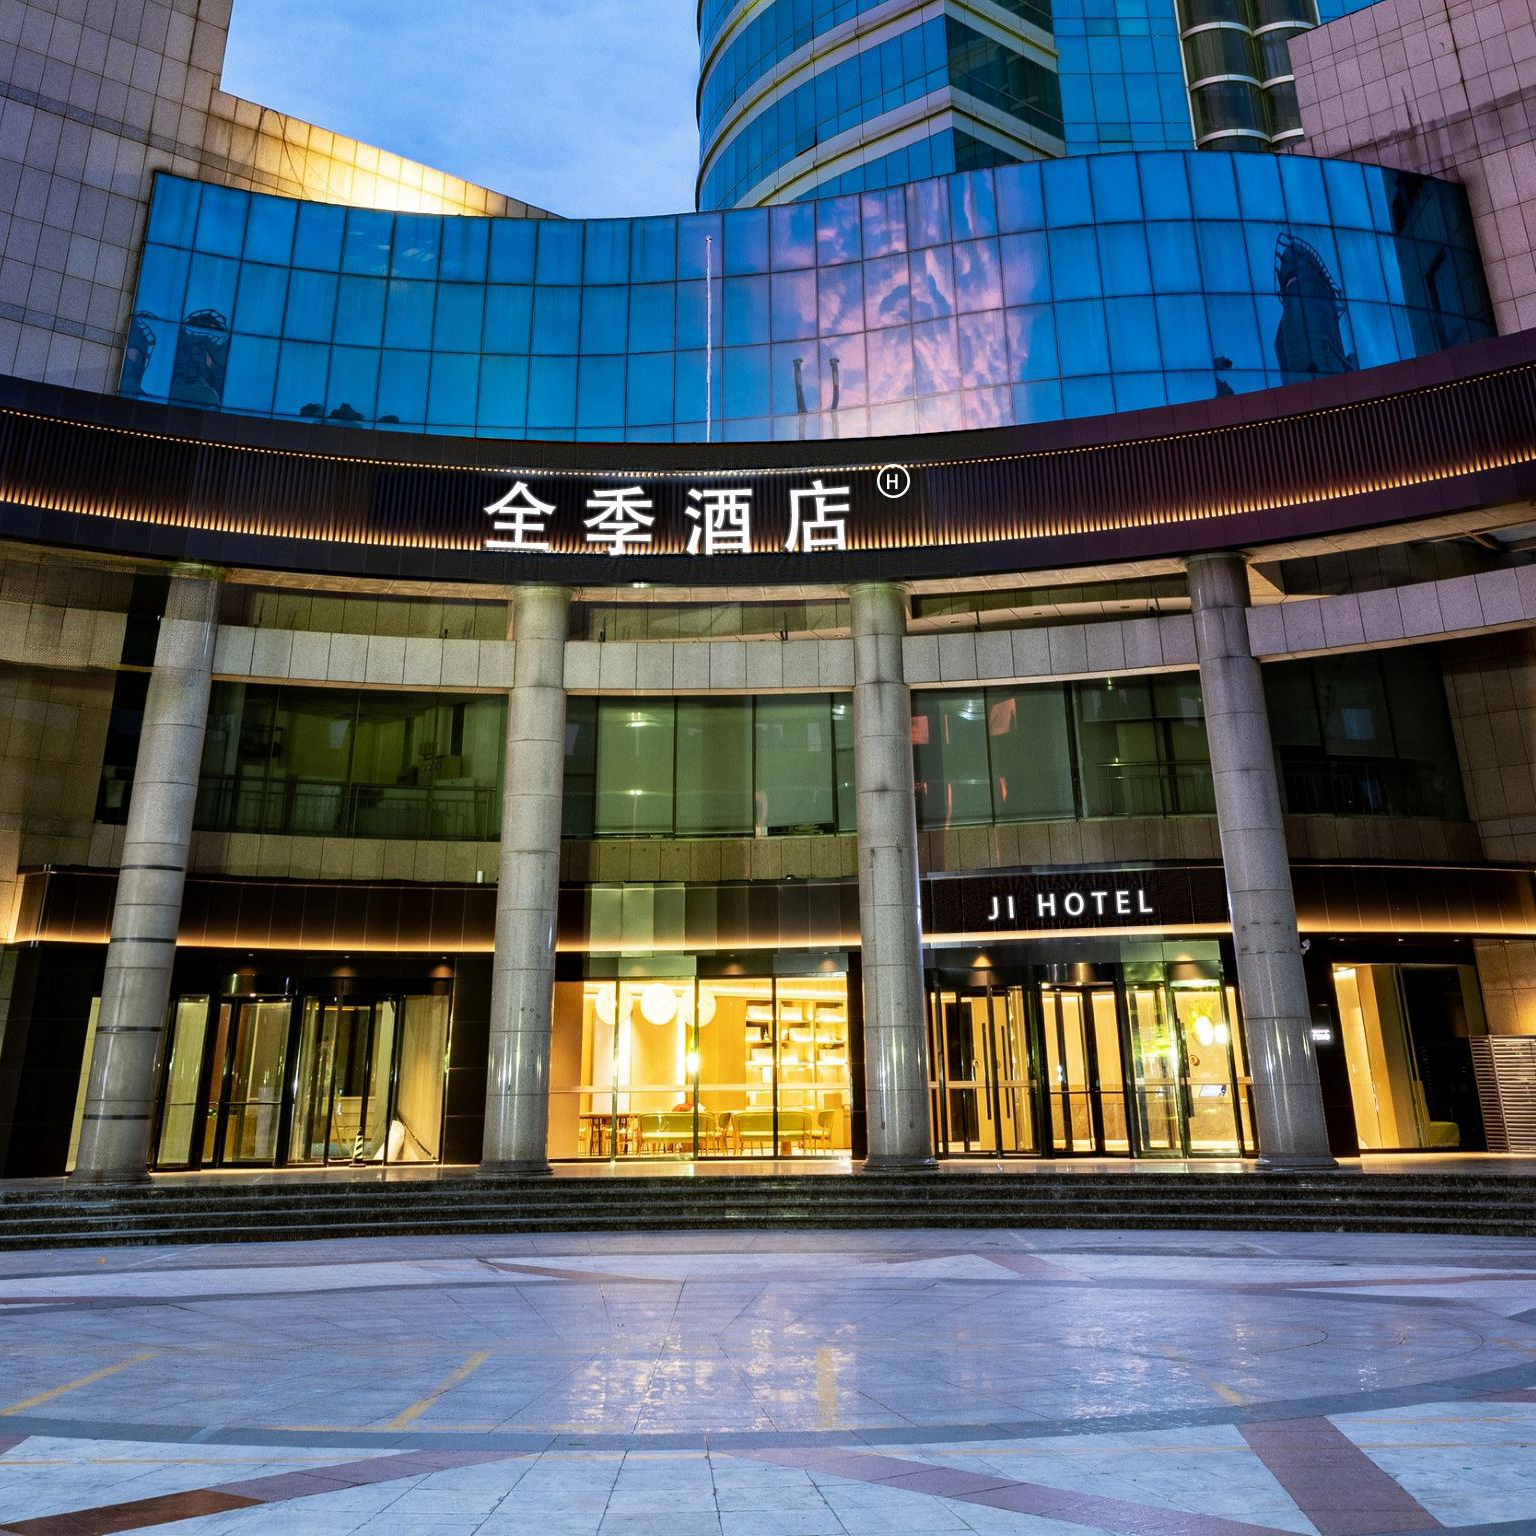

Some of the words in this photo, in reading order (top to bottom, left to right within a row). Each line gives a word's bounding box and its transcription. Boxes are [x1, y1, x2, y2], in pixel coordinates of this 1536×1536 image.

[483, 480, 851, 556] 全季酒店
[988, 896, 1014, 920] JI
[1037, 890, 1153, 917] HOTEL
